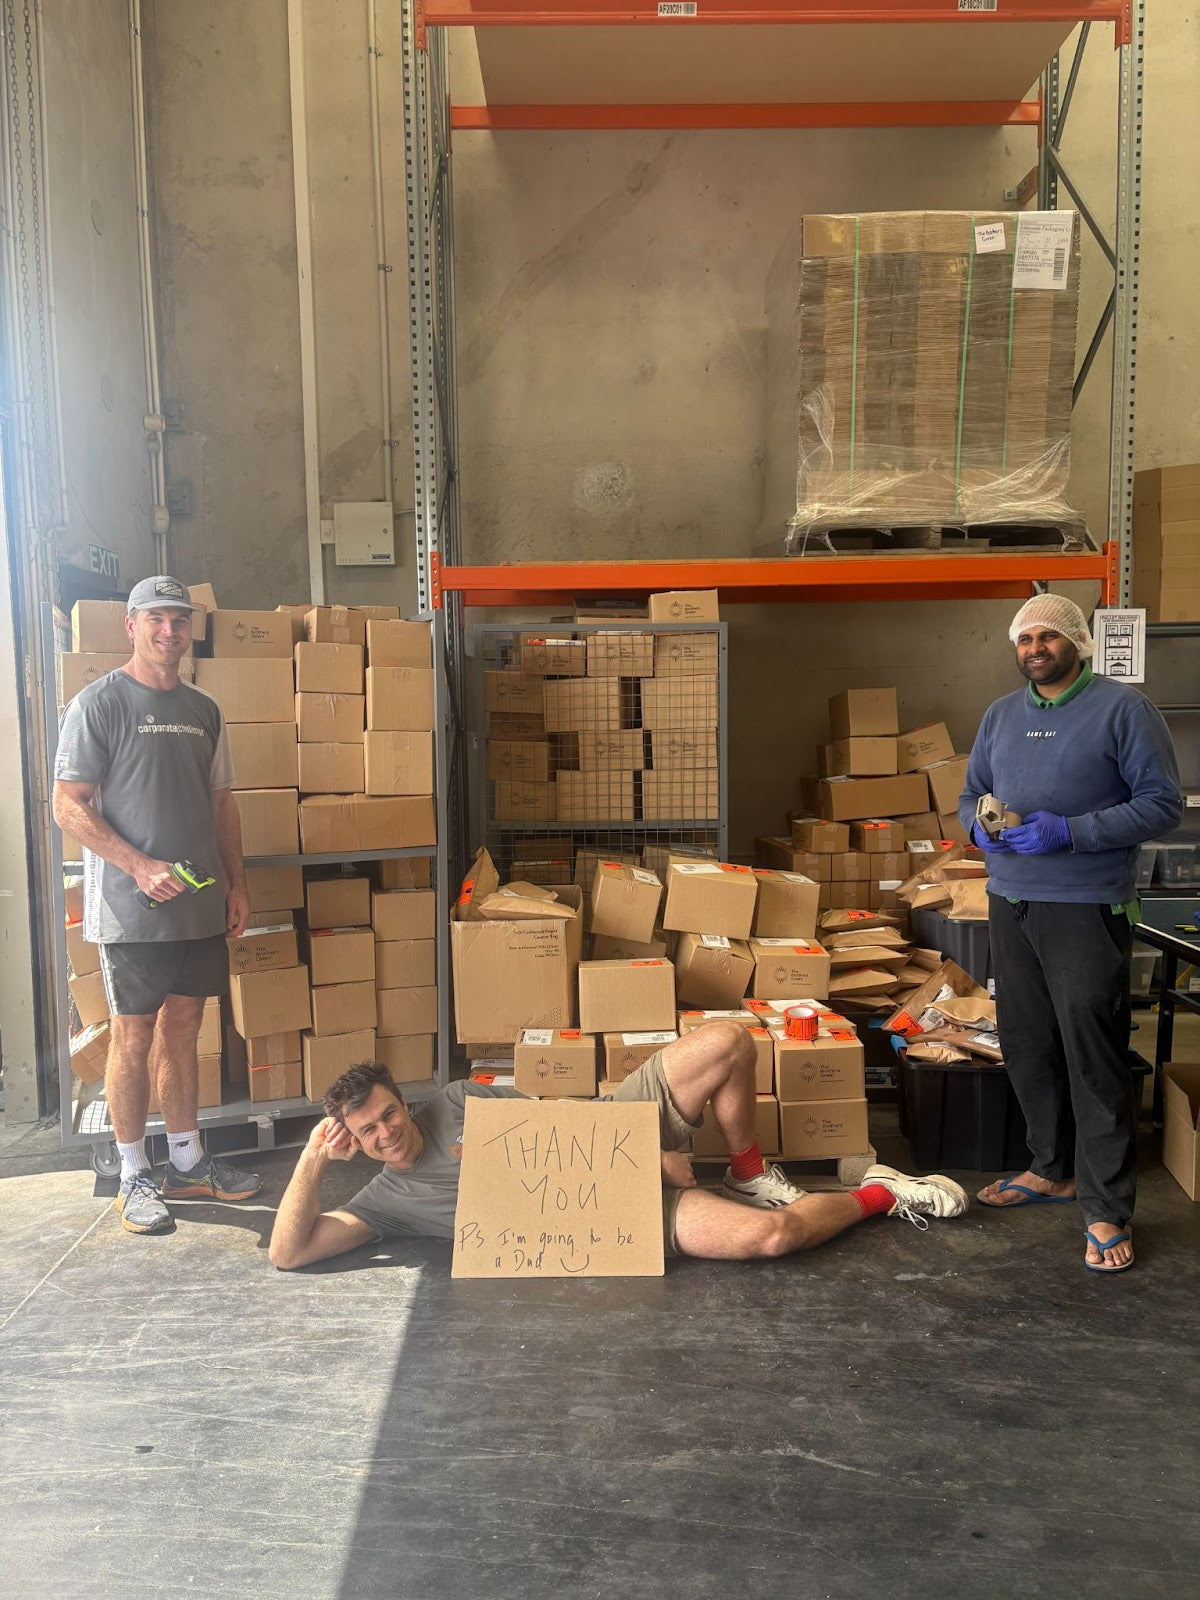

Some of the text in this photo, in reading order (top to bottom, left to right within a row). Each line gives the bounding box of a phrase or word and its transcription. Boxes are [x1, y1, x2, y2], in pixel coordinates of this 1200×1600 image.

[90, 545, 118, 577] EXIT
[482, 1119, 639, 1172] THANK
[521, 1174, 598, 1215] YOU
[497, 1228, 526, 1247] I'm
[540, 1226, 574, 1257] going
[617, 1227, 634, 1246] be
[495, 1250, 543, 1272] a Dad
